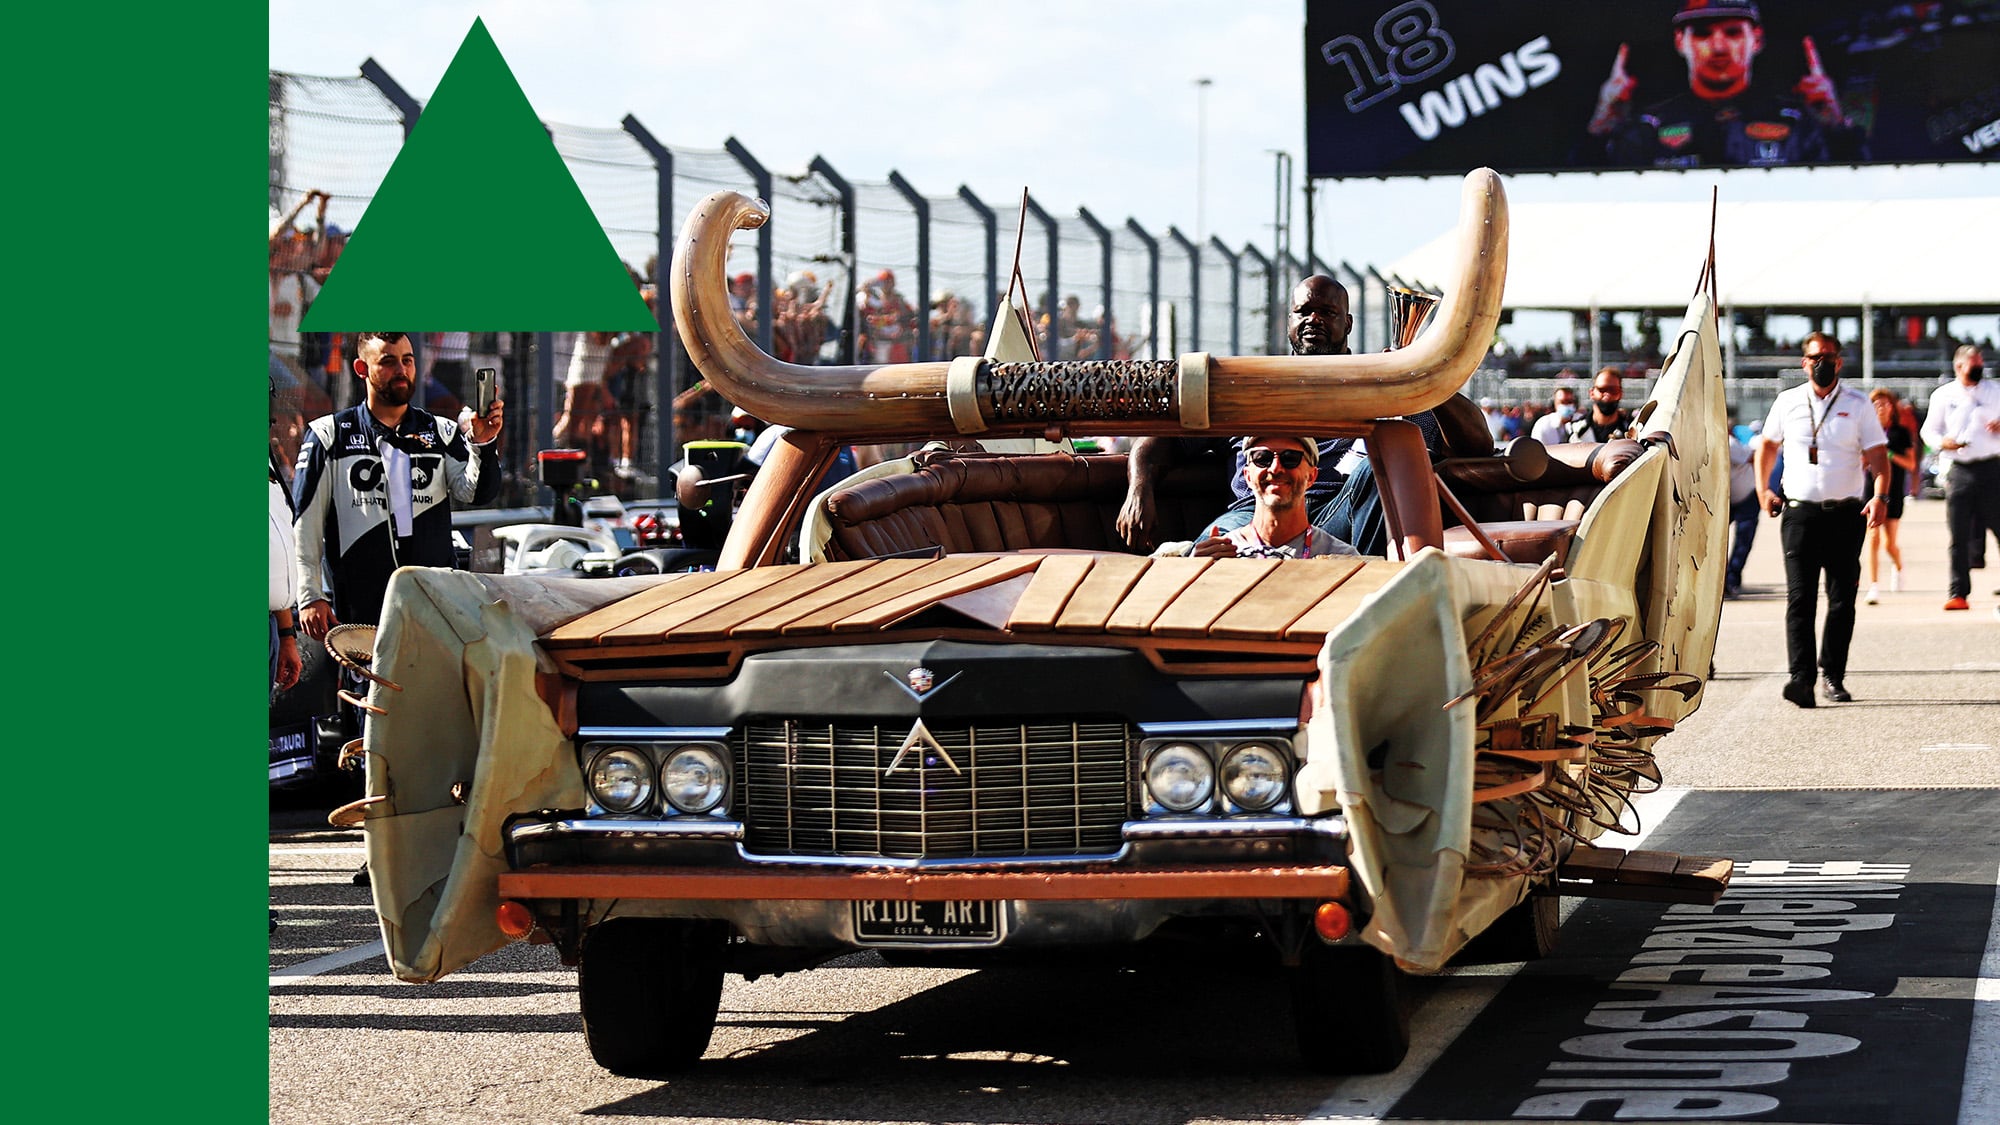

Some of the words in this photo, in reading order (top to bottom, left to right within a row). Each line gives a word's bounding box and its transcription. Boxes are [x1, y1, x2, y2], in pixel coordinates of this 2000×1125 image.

[1321, 0, 1457, 113] 18
[1399, 35, 1563, 141] WINS
[863, 900, 925, 922] RIDE
